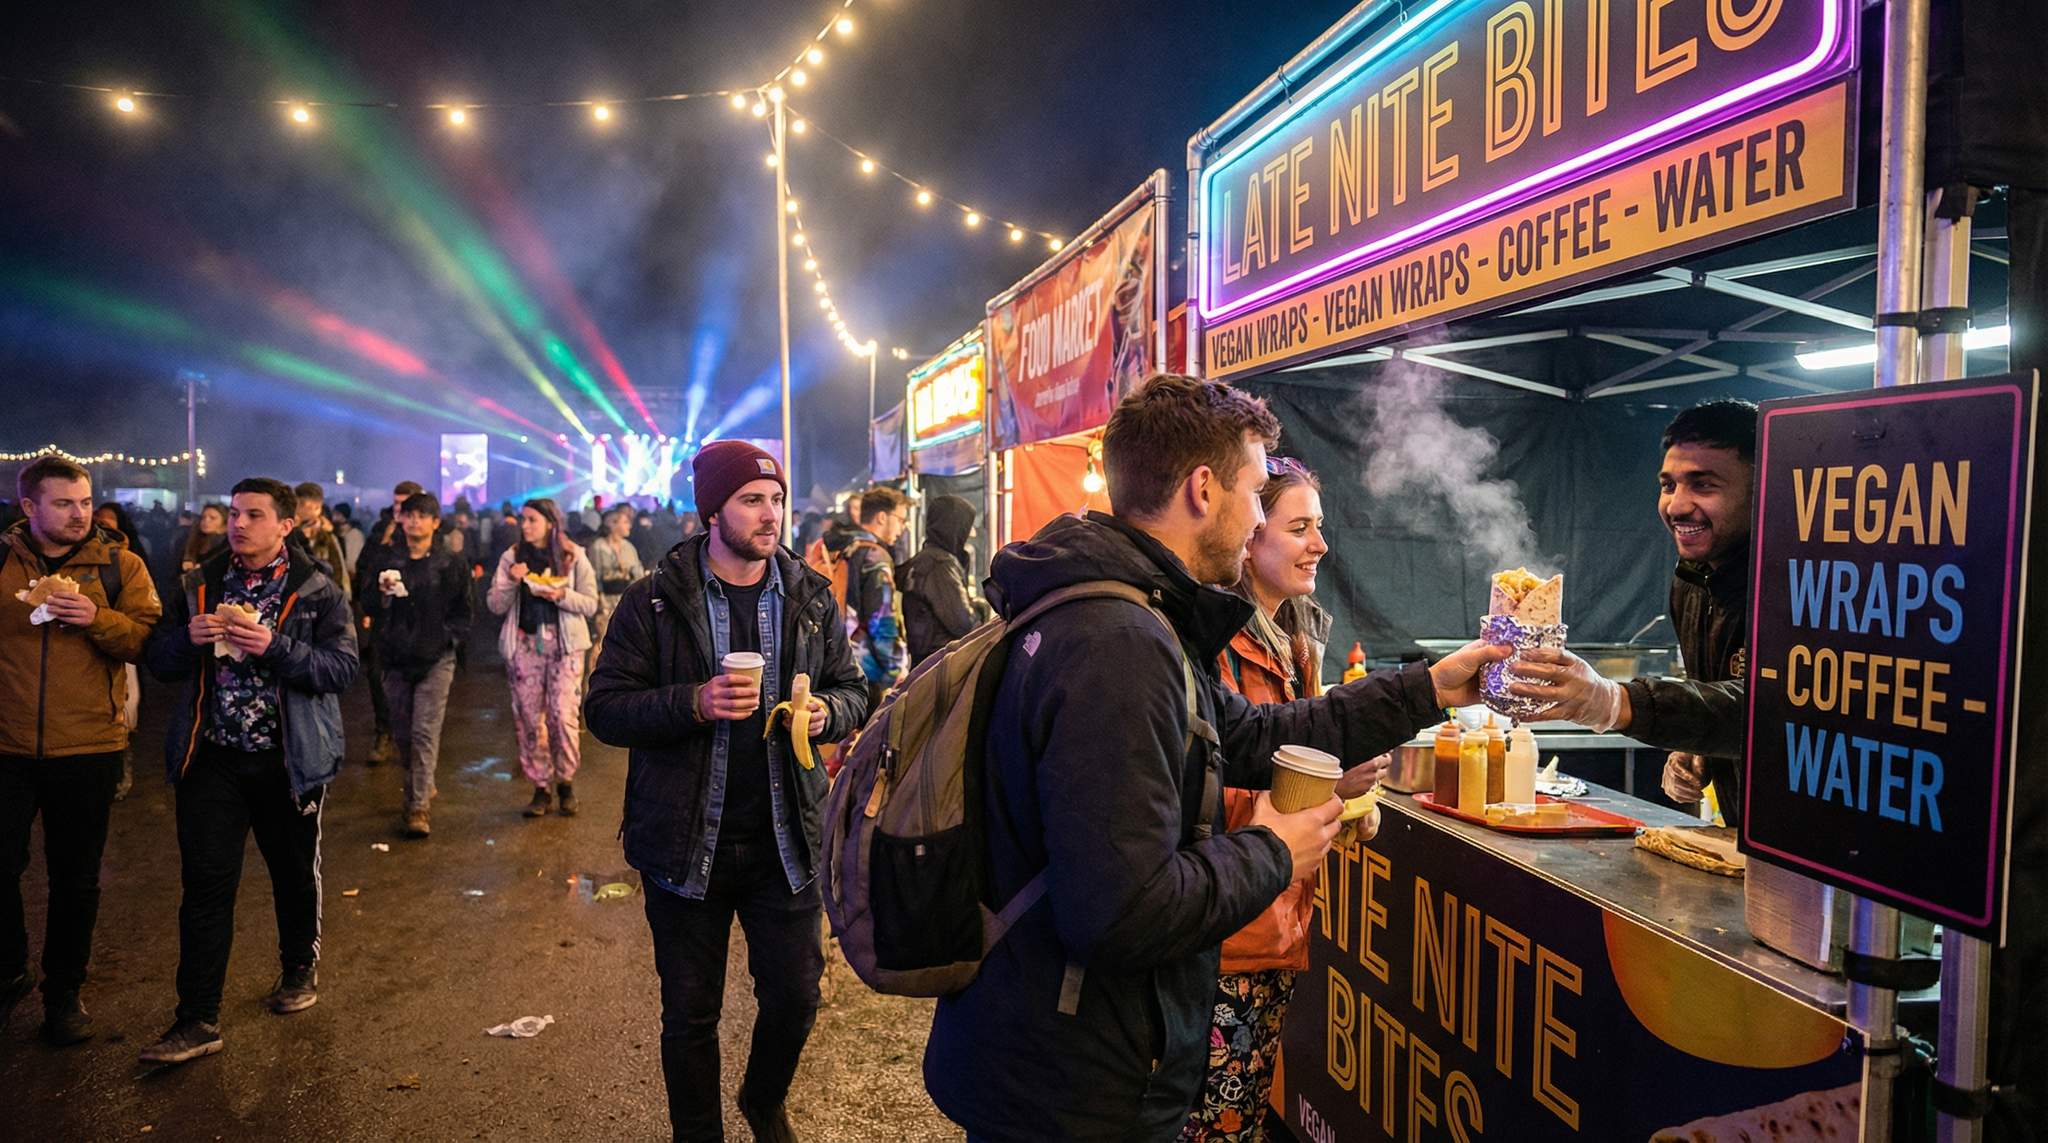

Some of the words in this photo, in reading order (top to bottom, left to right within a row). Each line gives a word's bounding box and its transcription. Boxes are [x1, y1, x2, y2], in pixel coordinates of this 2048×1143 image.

[1222, 135, 1314, 286] LATE
[1329, 39, 1460, 236] NITE
[1211, 322, 1253, 370] VEGAN
[1256, 302, 1309, 357] WRAPS
[1323, 273, 1384, 336] VEGAN
[1389, 242, 1470, 315] WRAPS
[1498, 188, 1612, 282] COFFEE
[1653, 118, 1806, 234] WATER
[1018, 312, 1051, 383] FOOD
[1052, 277, 1104, 369] MARKET
[1792, 460, 1970, 547] VEGAN
[1788, 558, 1966, 645] WRAPS
[1786, 644, 1951, 734] COFFEE
[1784, 721, 1944, 833] WATER
[1411, 875, 1583, 1132] NITE
